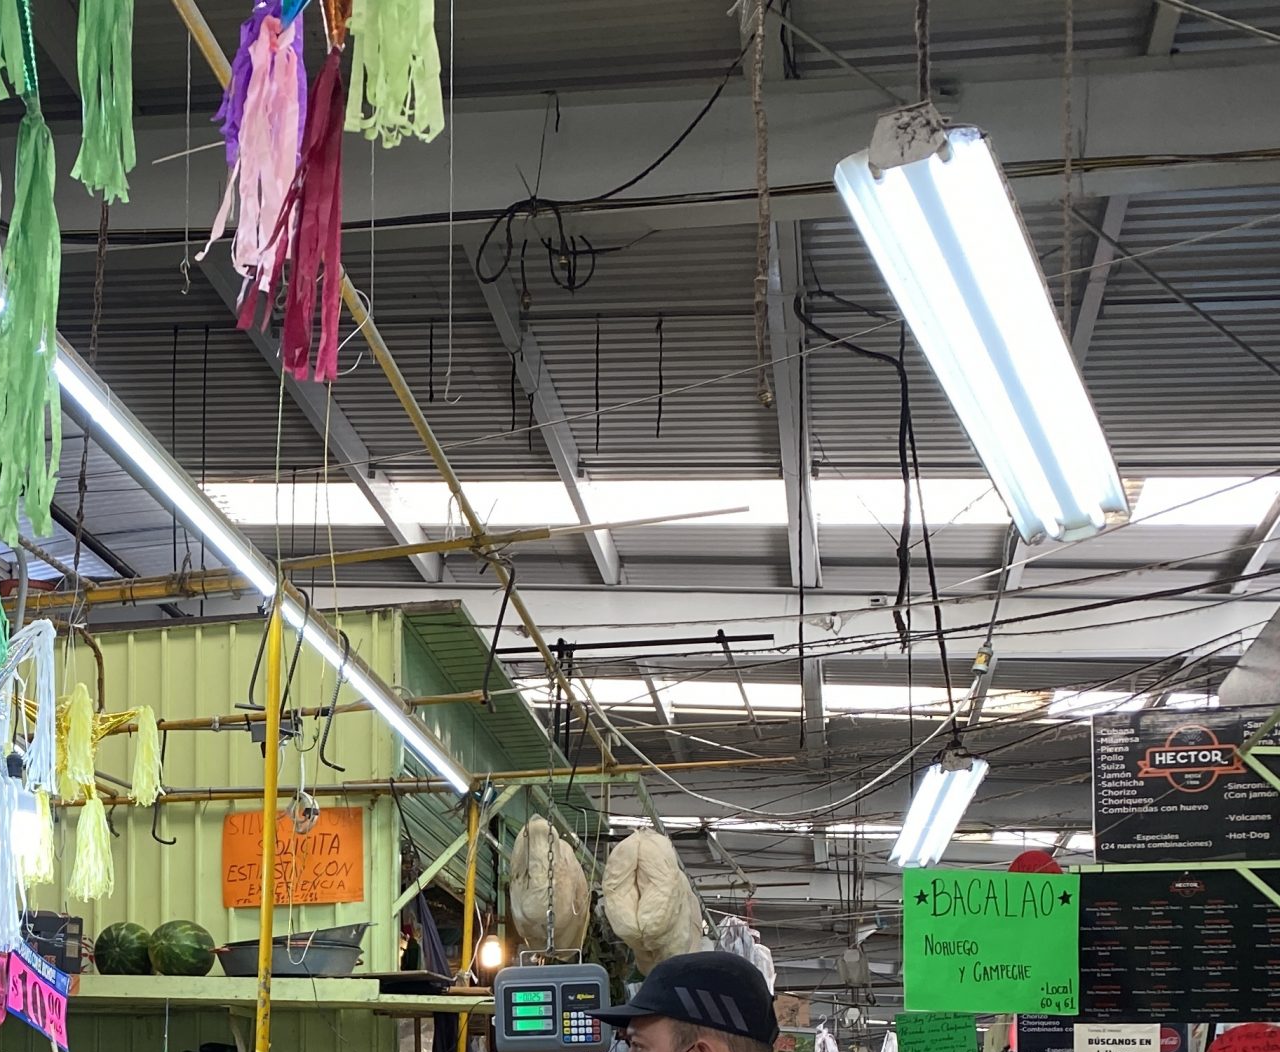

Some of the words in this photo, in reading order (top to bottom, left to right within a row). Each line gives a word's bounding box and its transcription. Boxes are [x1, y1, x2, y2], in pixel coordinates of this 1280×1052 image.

[1097, 728, 1135, 736] -Cubana
[1097, 736, 1140, 744] -Milanesa
[1097, 745, 1130, 753] -Pierna
[1154, 750, 1228, 765] HECTOR
[1097, 771, 1132, 779] -Jamón
[1098, 780, 1145, 788] -Salchicha
[1098, 797, 1154, 805] -Choriqueso
[1098, 805, 1158, 814] -Combinadas
[1179, 803, 1209, 811] huevo
[1225, 813, 1272, 822] -Volcanes
[1133, 832, 1180, 841] -Especiales
[1225, 831, 1271, 840] -Hot-Dog
[1100, 842, 1115, 850] (24
[1147, 840, 1213, 848] combinaciones)
[931, 878, 1054, 919] BACALAO
[924, 933, 979, 957] NORUEGO
[973, 961, 1032, 983] CAMPECHE
[1040, 997, 1052, 1009] 60
[1064, 997, 1076, 1010] 61
[1088, 1036, 1137, 1046] BÚSCANOS
[1139, 1038, 1152, 1046] EN
